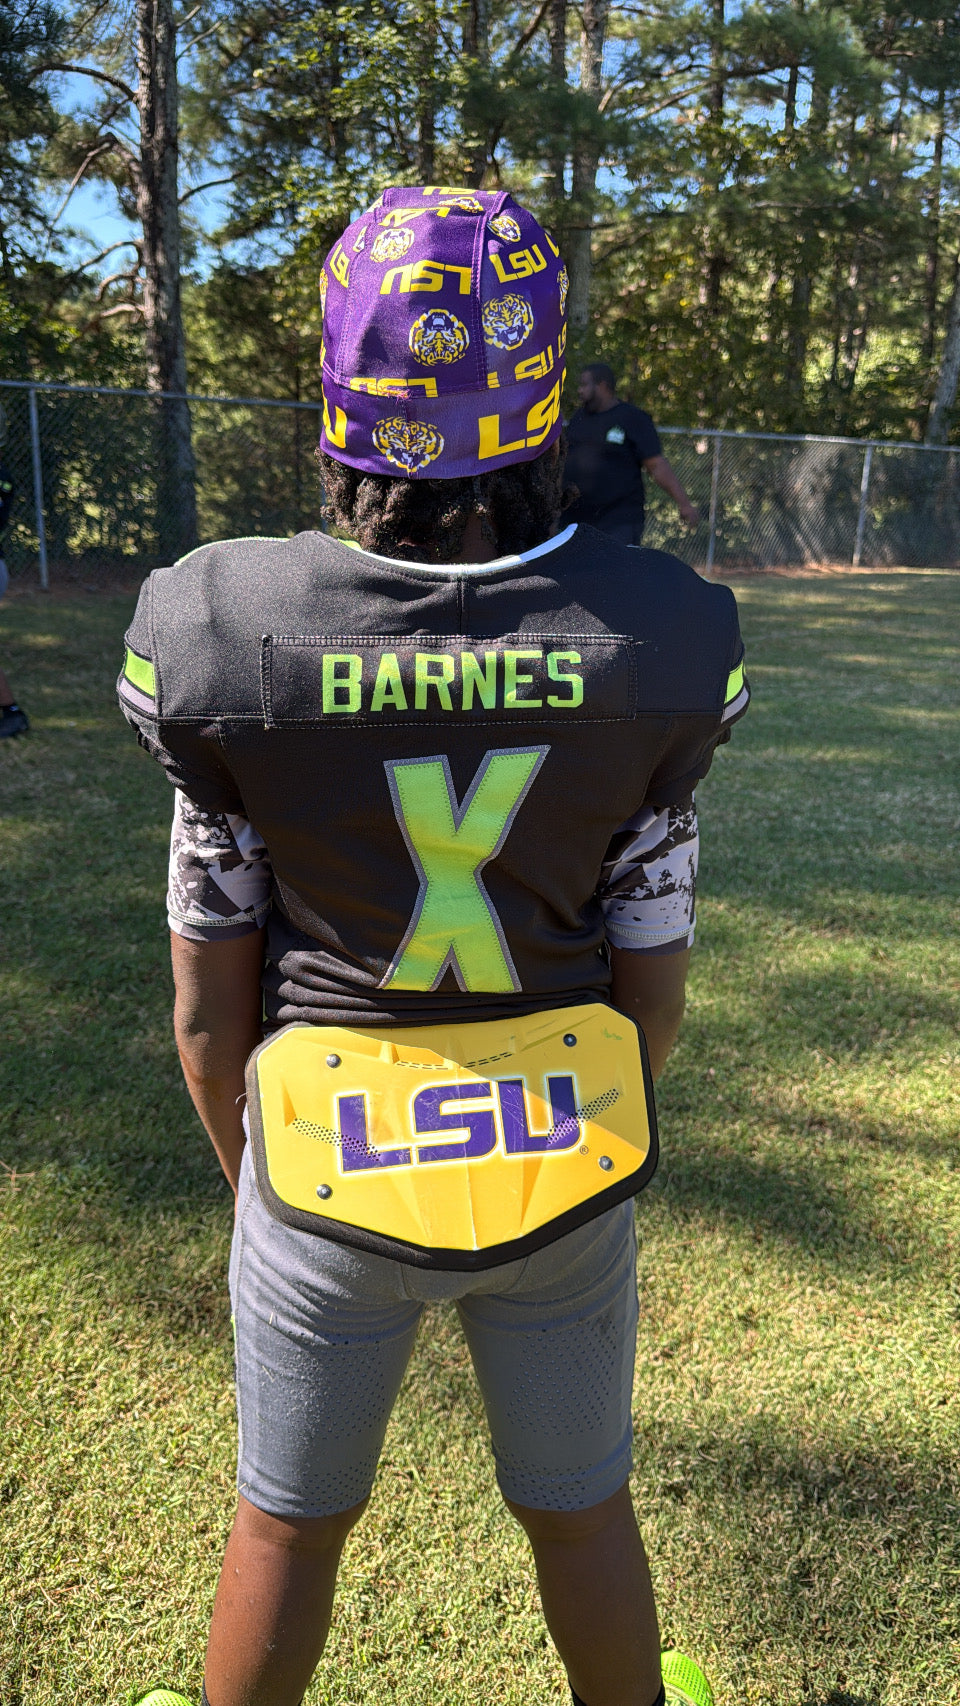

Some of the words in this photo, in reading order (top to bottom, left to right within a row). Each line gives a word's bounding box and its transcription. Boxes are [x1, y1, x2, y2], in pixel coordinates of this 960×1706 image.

[380, 260, 472, 295] LSU
[489, 244, 548, 284] LSU
[322, 650, 584, 714] BARNES
[378, 744, 552, 993] X
[335, 1073, 584, 1176] LSU
